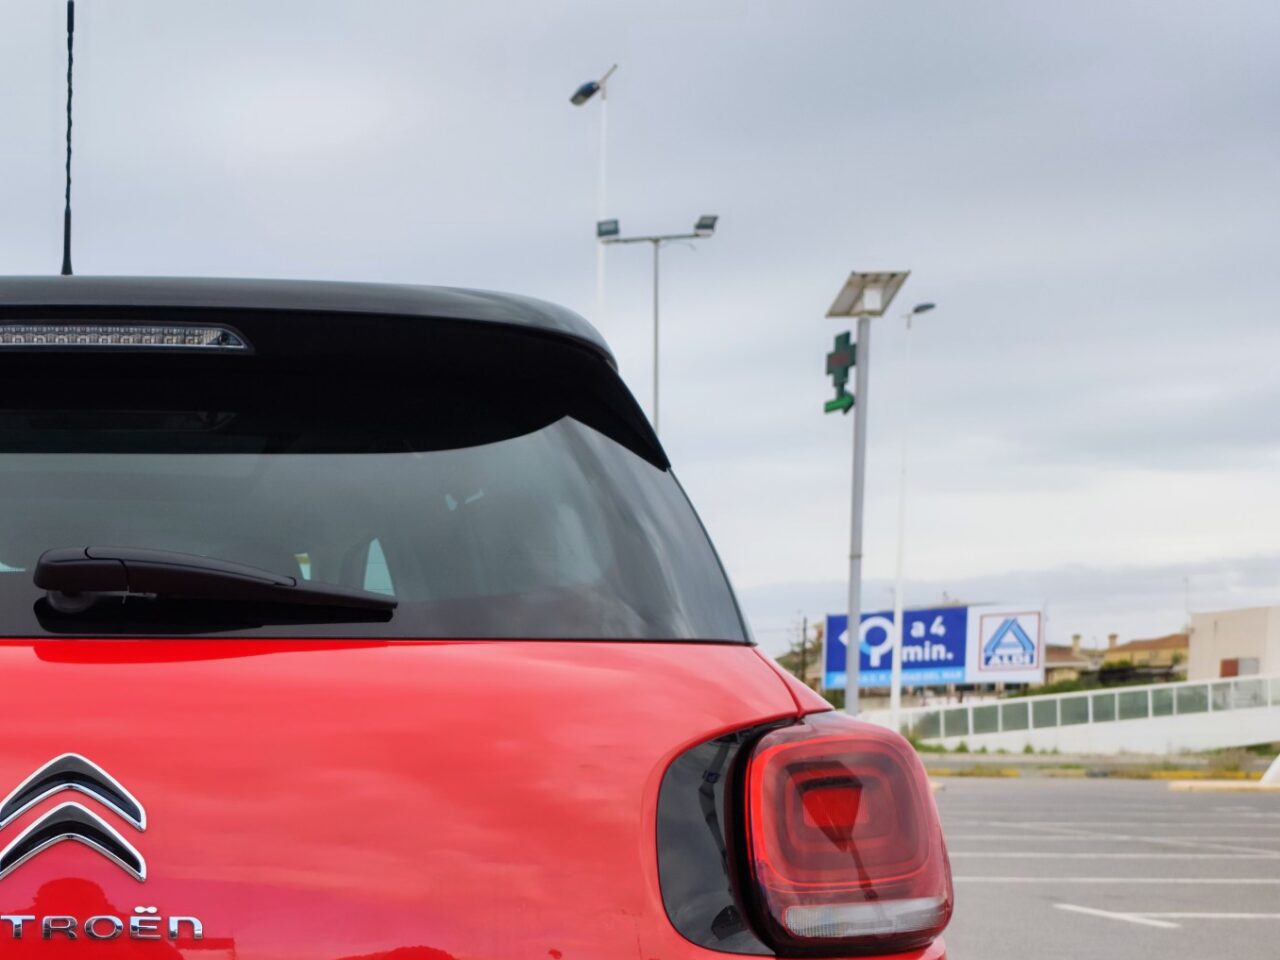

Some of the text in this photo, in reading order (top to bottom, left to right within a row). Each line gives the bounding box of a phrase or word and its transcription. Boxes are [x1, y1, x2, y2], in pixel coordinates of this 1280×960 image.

[910, 615, 946, 638] a 4
[902, 640, 954, 662] min.
[986, 654, 1032, 665] ALDI
